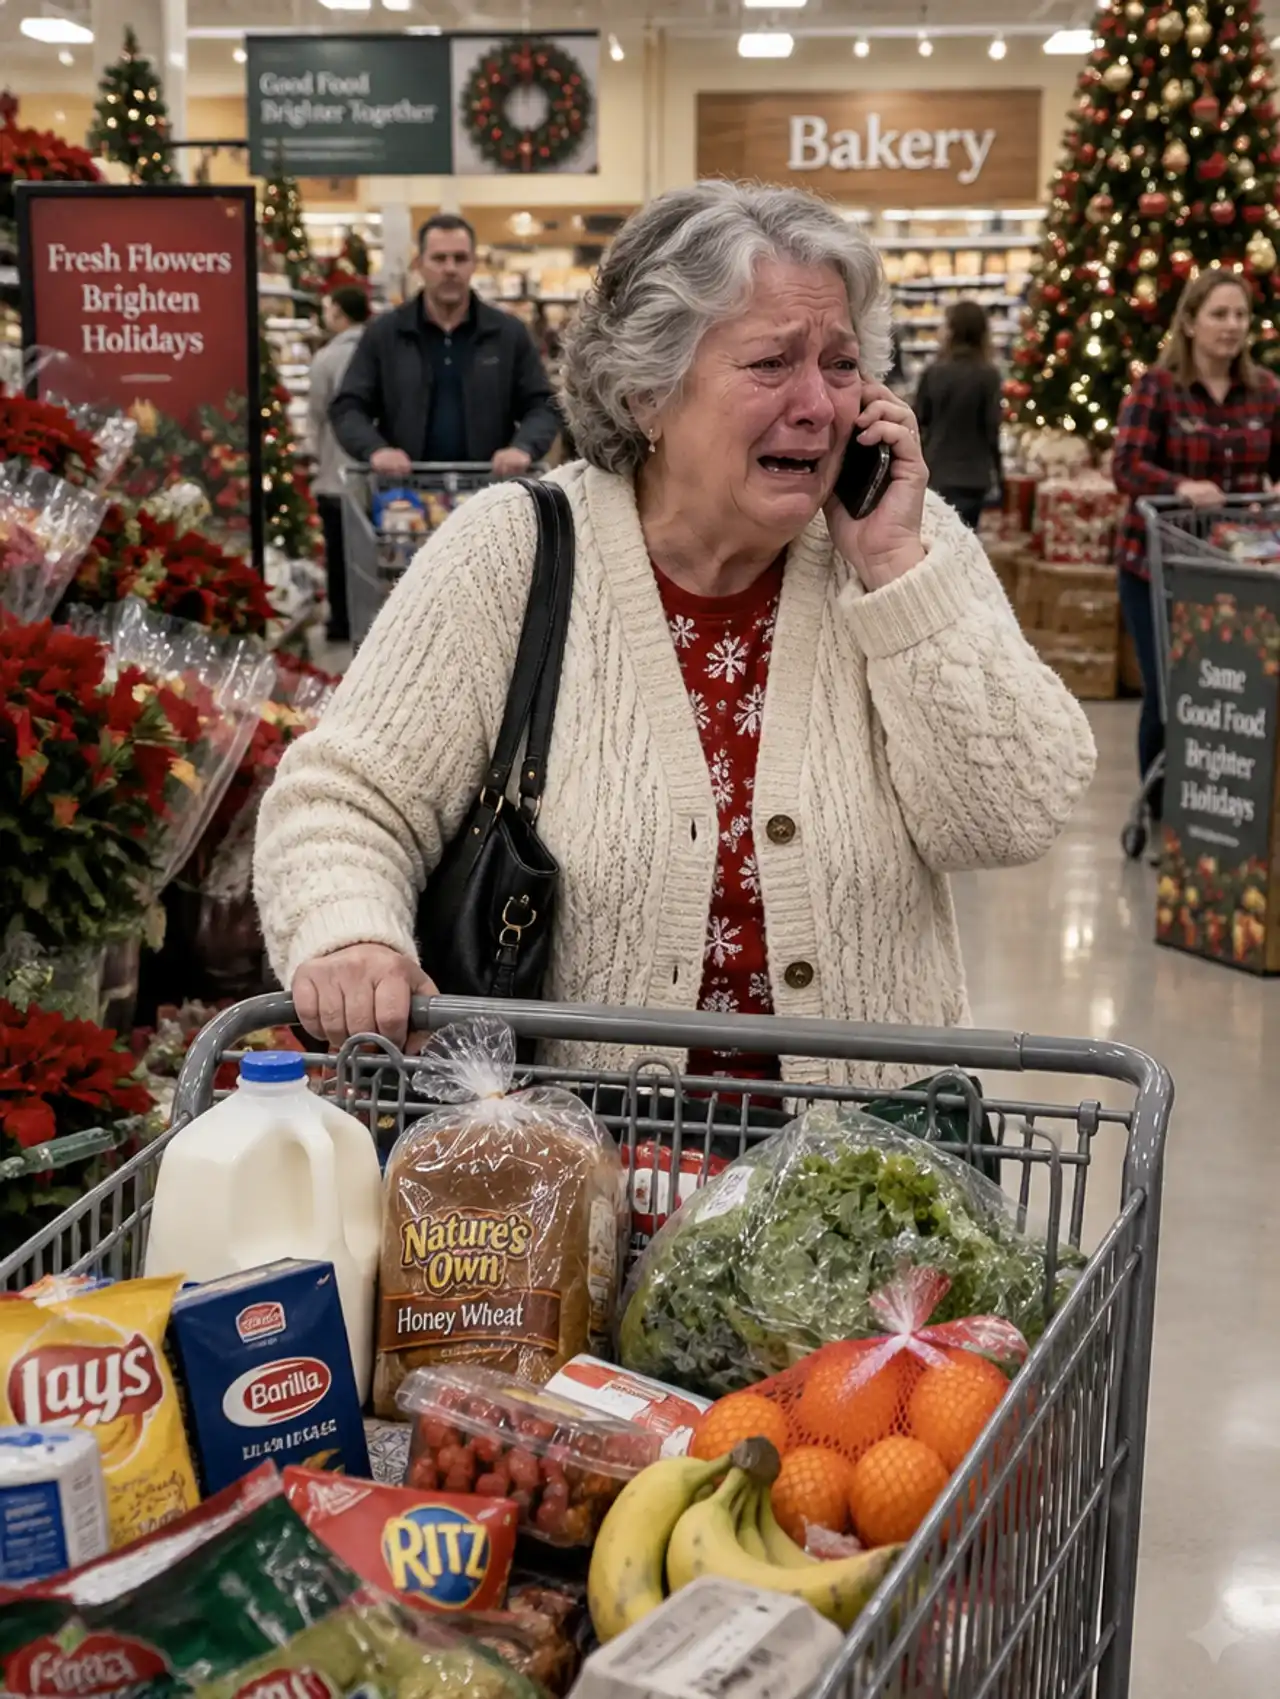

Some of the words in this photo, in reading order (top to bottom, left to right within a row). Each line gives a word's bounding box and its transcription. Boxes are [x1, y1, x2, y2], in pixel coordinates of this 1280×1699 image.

[259, 70, 314, 96] Good
[316, 70, 371, 96] Food
[787, 112, 996, 184] Bakery
[48, 242, 121, 273] Fresh
[126, 242, 232, 273] Flowers
[81, 283, 200, 320] Brighten
[81, 324, 204, 361] Holidays
[1198, 658, 1247, 693] Same
[1177, 694, 1222, 731] Good
[1223, 701, 1266, 740] Food
[1184, 737, 1256, 781] Brighter
[1180, 780, 1255, 827] Holidays
[403, 1213, 530, 1264] Nature's
[428, 1251, 499, 1289] Own
[397, 1306, 457, 1335] Honey
[461, 1302, 524, 1328] Wheat
[250, 1370, 324, 1411] Barilla
[386, 1516, 487, 1590] RITZ
